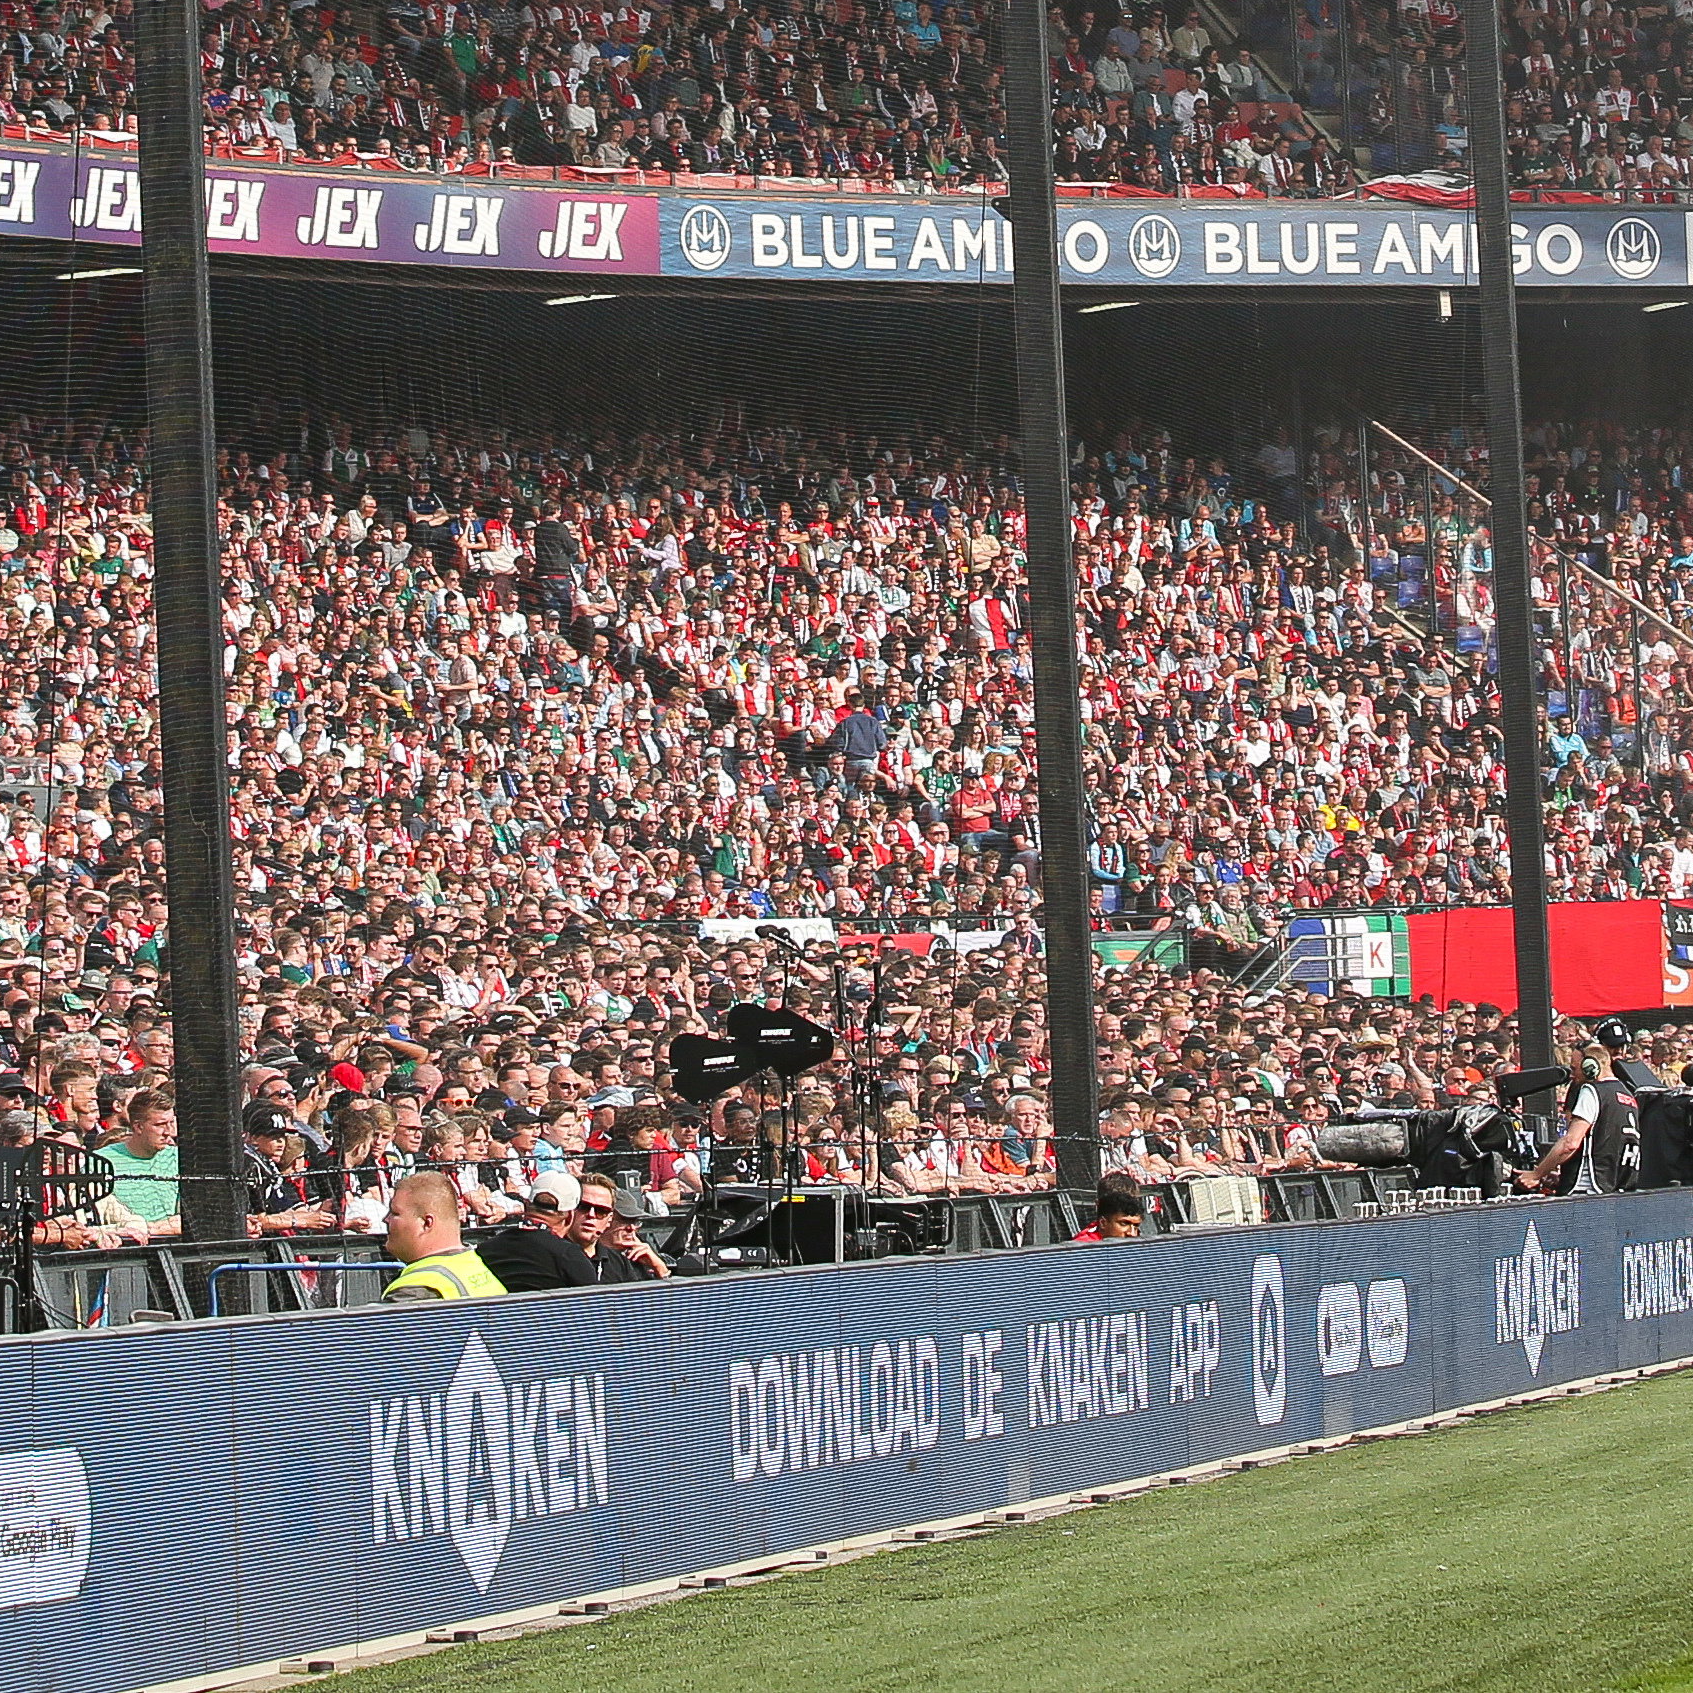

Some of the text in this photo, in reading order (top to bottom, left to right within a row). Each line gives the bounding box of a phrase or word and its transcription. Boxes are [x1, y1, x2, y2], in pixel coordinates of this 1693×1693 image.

[206, 179, 265, 243] EX
[296, 186, 386, 251] JEX
[413, 192, 504, 258] JEX
[538, 200, 628, 262] JEX
[751, 211, 1109, 276] BLUE AMIO
[1204, 220, 1362, 275] BLUE
[1369, 939, 1385, 969] K
[729, 1298, 1222, 1483] DOWNLOAD DE KNAKEN APP
[369, 1370, 610, 1545] KNAKEN
